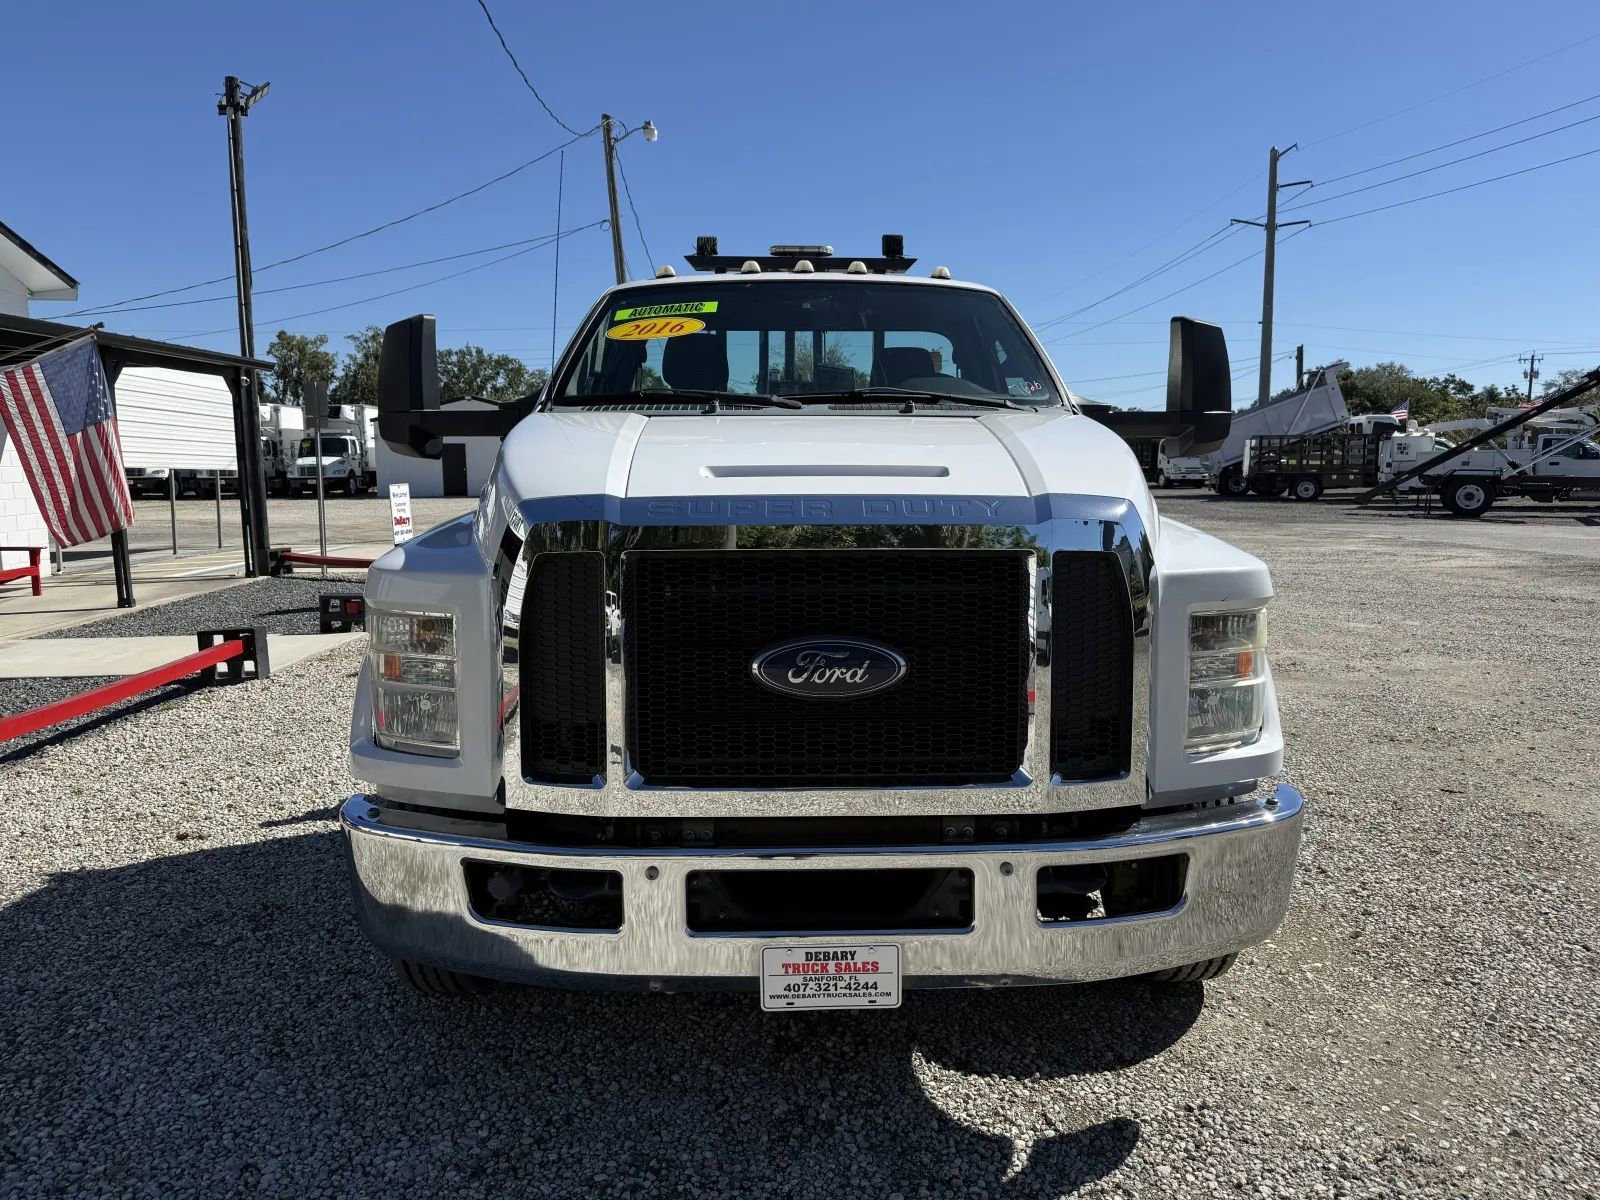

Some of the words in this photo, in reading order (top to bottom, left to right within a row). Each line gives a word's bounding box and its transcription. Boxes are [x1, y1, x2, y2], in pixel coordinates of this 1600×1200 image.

[628, 303, 705, 318] AUTOMATIC
[620, 321, 689, 338] 2016
[647, 499, 834, 518] SUPER
[862, 499, 1003, 518] DUTY
[787, 650, 871, 684] Ford
[805, 950, 857, 962] DEBARY
[781, 962, 830, 974] TRUCK
[834, 961, 880, 974] SALES
[802, 975, 847, 983] SANFORD,
[783, 981, 879, 993] 407-321-4244
[769, 991, 892, 1000] WWW.DEBARYTRUCKSALES.COM
